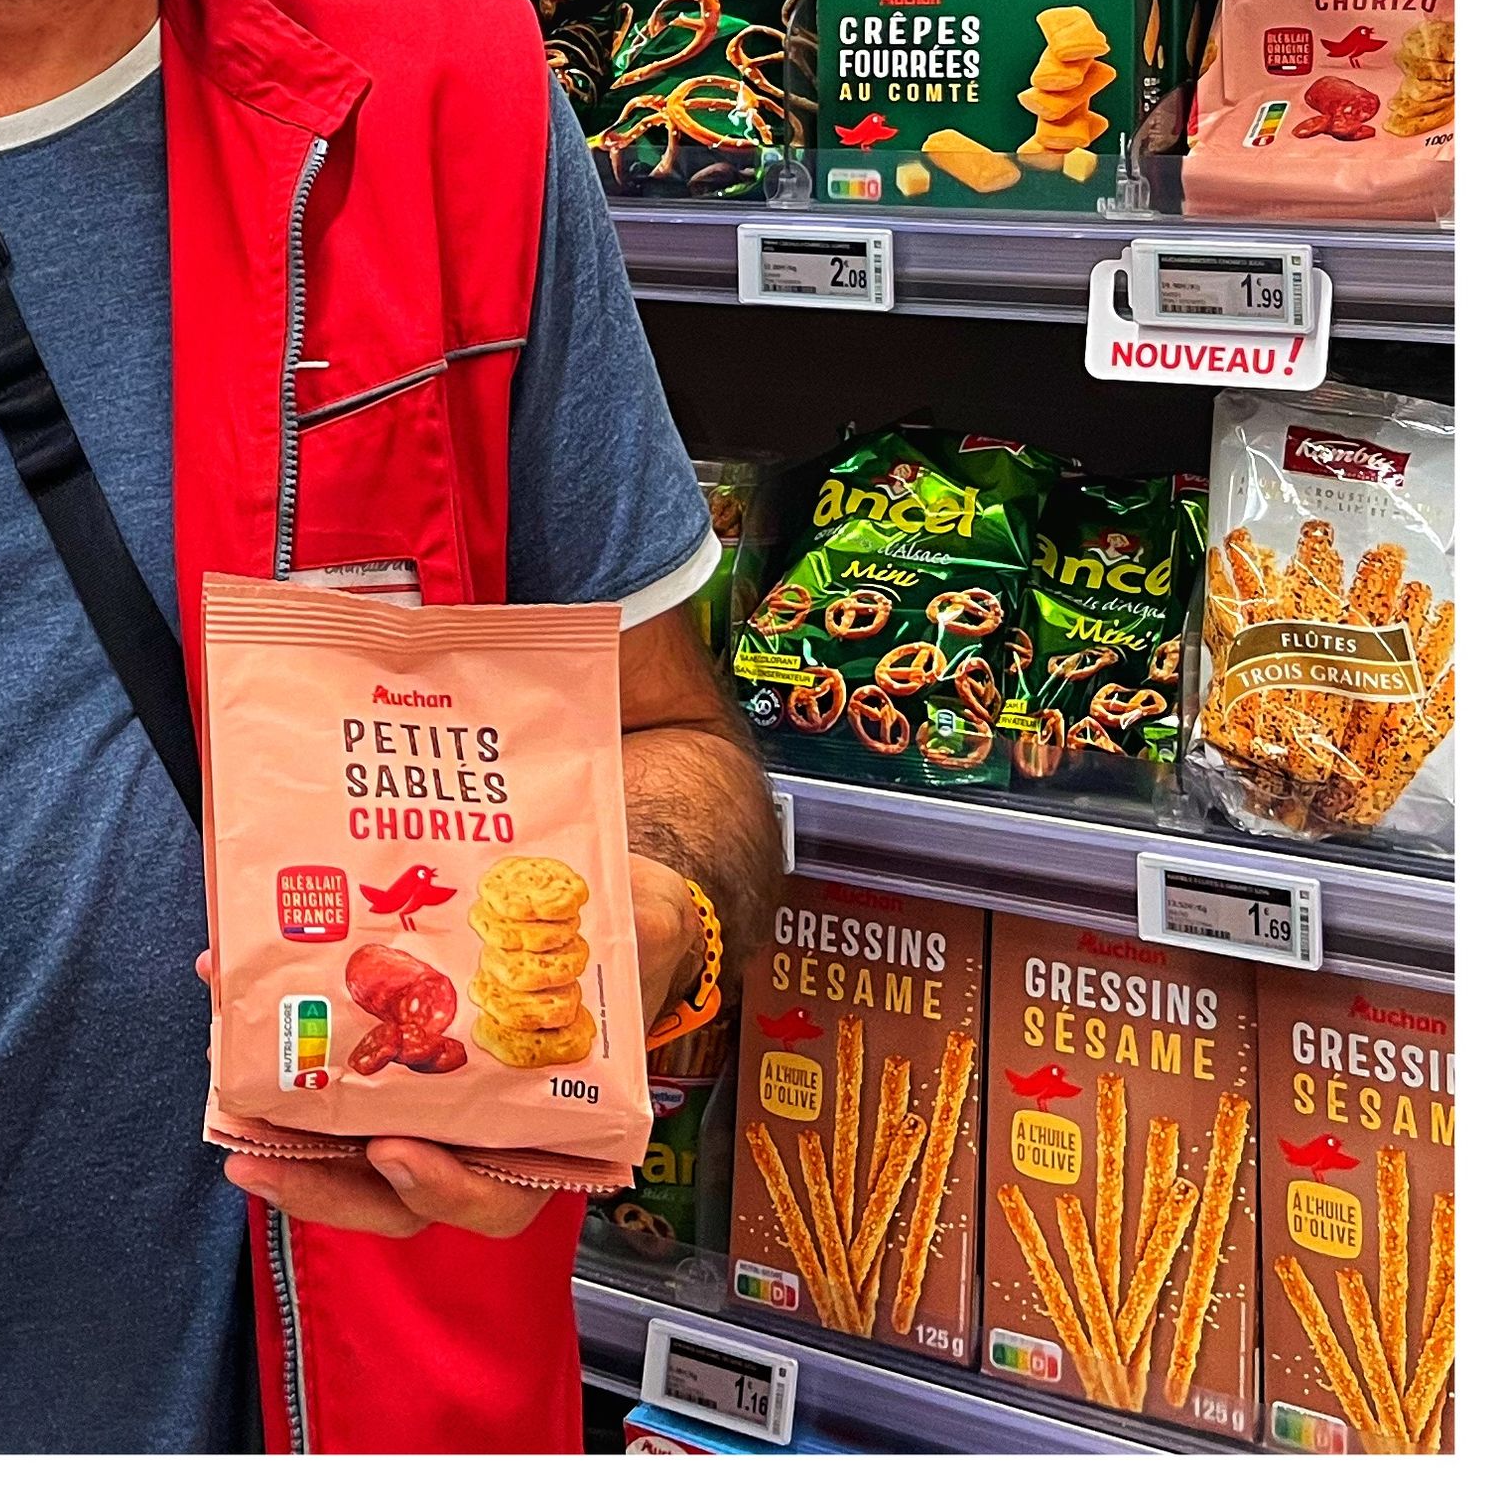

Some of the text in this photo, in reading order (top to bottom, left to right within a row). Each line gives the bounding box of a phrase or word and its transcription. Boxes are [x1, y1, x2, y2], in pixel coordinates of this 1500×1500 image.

[839, 11, 981, 46] CRÊPES
[839, 44, 980, 79] FOURRÉES
[1267, 44, 1310, 55] ORIGINE
[1267, 54, 1309, 66] FRANCE
[839, 80, 979, 103] AU COMTÉ
[1111, 340, 1276, 375] NOUVEAU
[813, 478, 979, 538] ancel
[840, 560, 919, 587] Mini
[1031, 532, 1173, 596] ance
[1065, 615, 1152, 651] Mini
[1280, 628, 1357, 656] FLÛTES
[1237, 661, 1407, 691] TROIS GRAINES
[372, 685, 452, 709] Auchan
[343, 717, 501, 764] PETITS
[346, 762, 509, 805] SABLÉS
[349, 807, 516, 845] CHORIZO
[283, 892, 344, 908] ORIGINE
[284, 909, 345, 924] FRANCE
[775, 906, 946, 972] GRESSINS
[1076, 933, 1168, 967] Auchan
[772, 949, 943, 1020] SÉSAME
[1024, 957, 1219, 1030] GRESSINS
[1350, 995, 1448, 1036] Auchan
[284, 1003, 293, 1073] NUTRI-SCORE
[1023, 1004, 1216, 1081] SÉSAME
[549, 1076, 600, 1104] 100g
[764, 1082, 817, 1111] D'OLIVE
[1030, 1124, 1076, 1152] L'HUILE
[1017, 1143, 1076, 1174] D'OLIVE
[1305, 1194, 1357, 1226] L'HUILE
[1293, 1213, 1356, 1247] D'OLIVE
[915, 1323, 949, 1349] 125
[1192, 1396, 1228, 1425] 125
